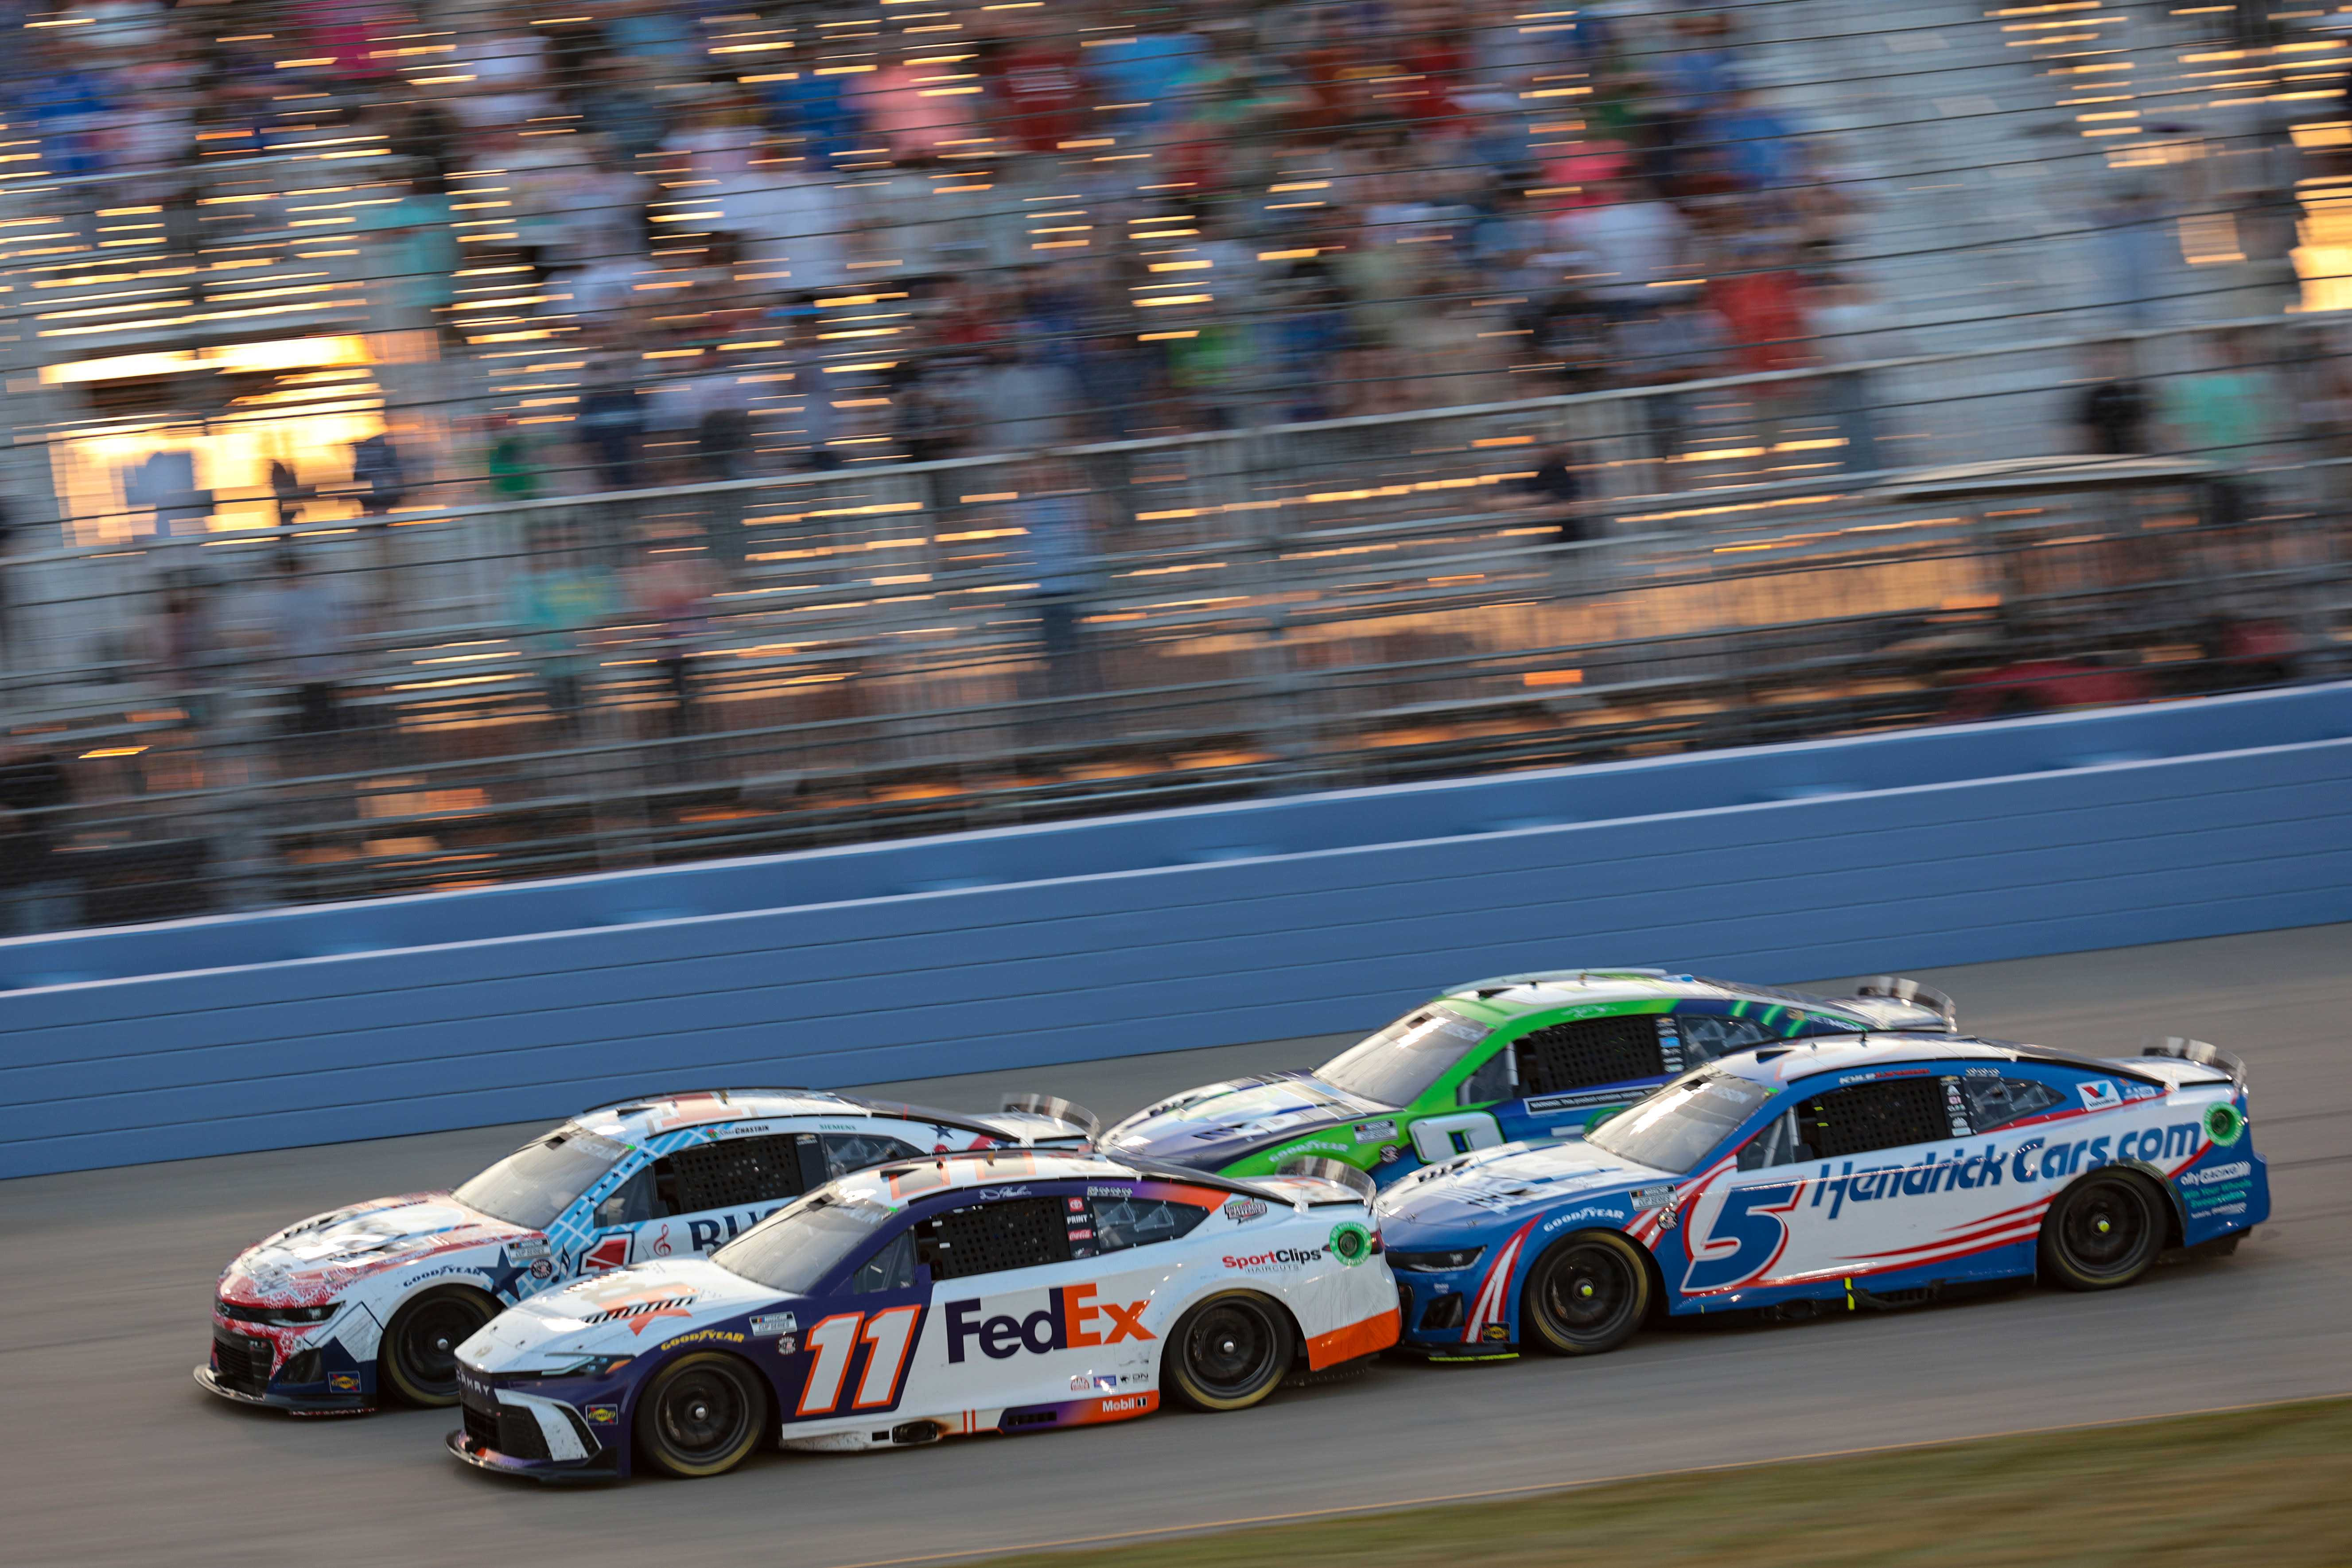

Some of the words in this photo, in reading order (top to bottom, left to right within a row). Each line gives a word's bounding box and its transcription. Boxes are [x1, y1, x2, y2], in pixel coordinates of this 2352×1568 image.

[735, 1124, 770, 1135] CHASTAIN
[1066, 1214, 1088, 1225] PRINT
[1543, 1206, 1625, 1232] GOODYEAR
[1680, 1179, 1808, 1296] 5
[1222, 1248, 1322, 1270] SportClips
[1248, 1264, 1299, 1273] HAIRCUTS
[403, 1265, 483, 1288] GOODYEAR
[758, 1323, 770, 1331] CUP
[770, 1321, 789, 1330] SERIES
[764, 1313, 787, 1323] NASCAR
[945, 1282, 1158, 1364] FedEx
[661, 1329, 745, 1351] GOODYEAR
[795, 1304, 922, 1416] 11
[1102, 1397, 1135, 1412] Mobil
